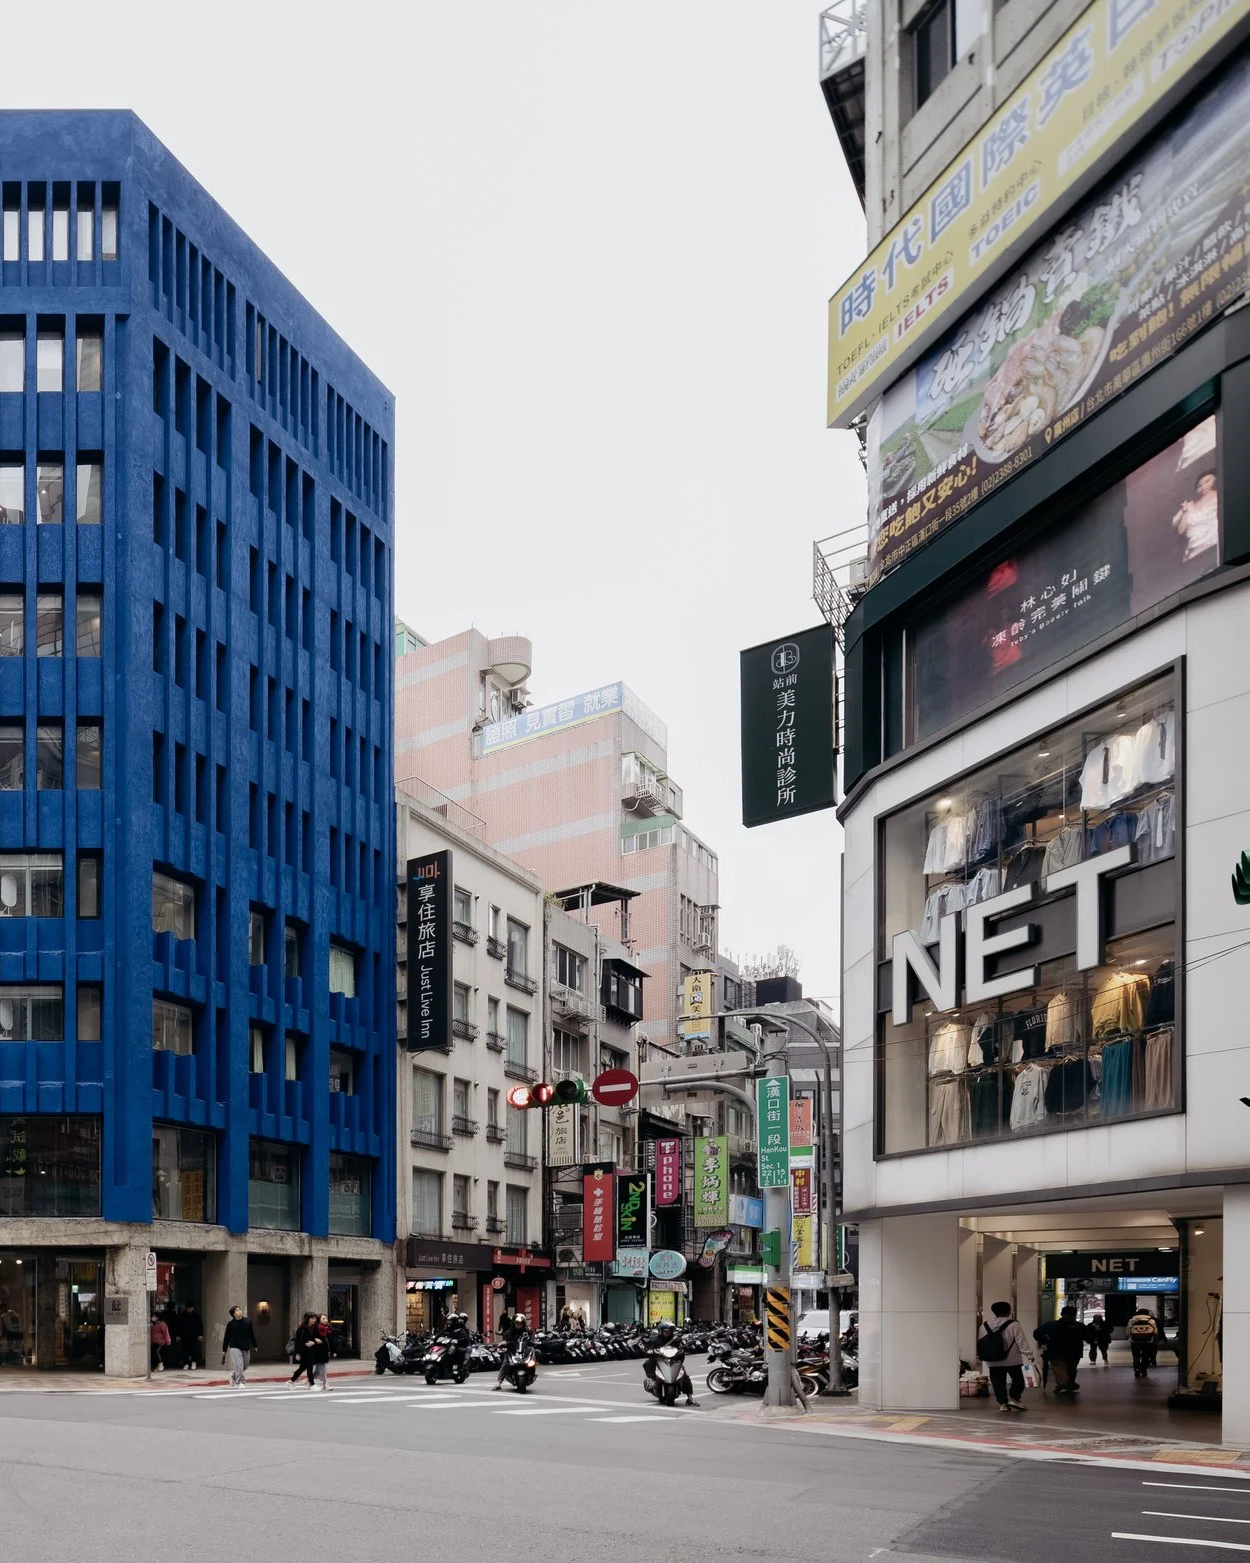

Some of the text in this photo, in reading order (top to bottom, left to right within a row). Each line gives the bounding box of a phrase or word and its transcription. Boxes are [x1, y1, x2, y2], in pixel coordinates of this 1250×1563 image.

[971, 183, 1040, 259] TOEIC
[897, 275, 950, 338] IELTS
[772, 673, 798, 690] 站前
[485, 685, 619, 747] 證照 見實習 就業
[776, 689, 797, 806] 美力時尚診所
[418, 883, 436, 1039] 享住旅店 Just Live Inn
[891, 844, 1133, 1027] NET
[767, 1087, 781, 1146] 漢口街一段
[795, 1169, 805, 1185] 中村
[1091, 1258, 1140, 1272] NET
